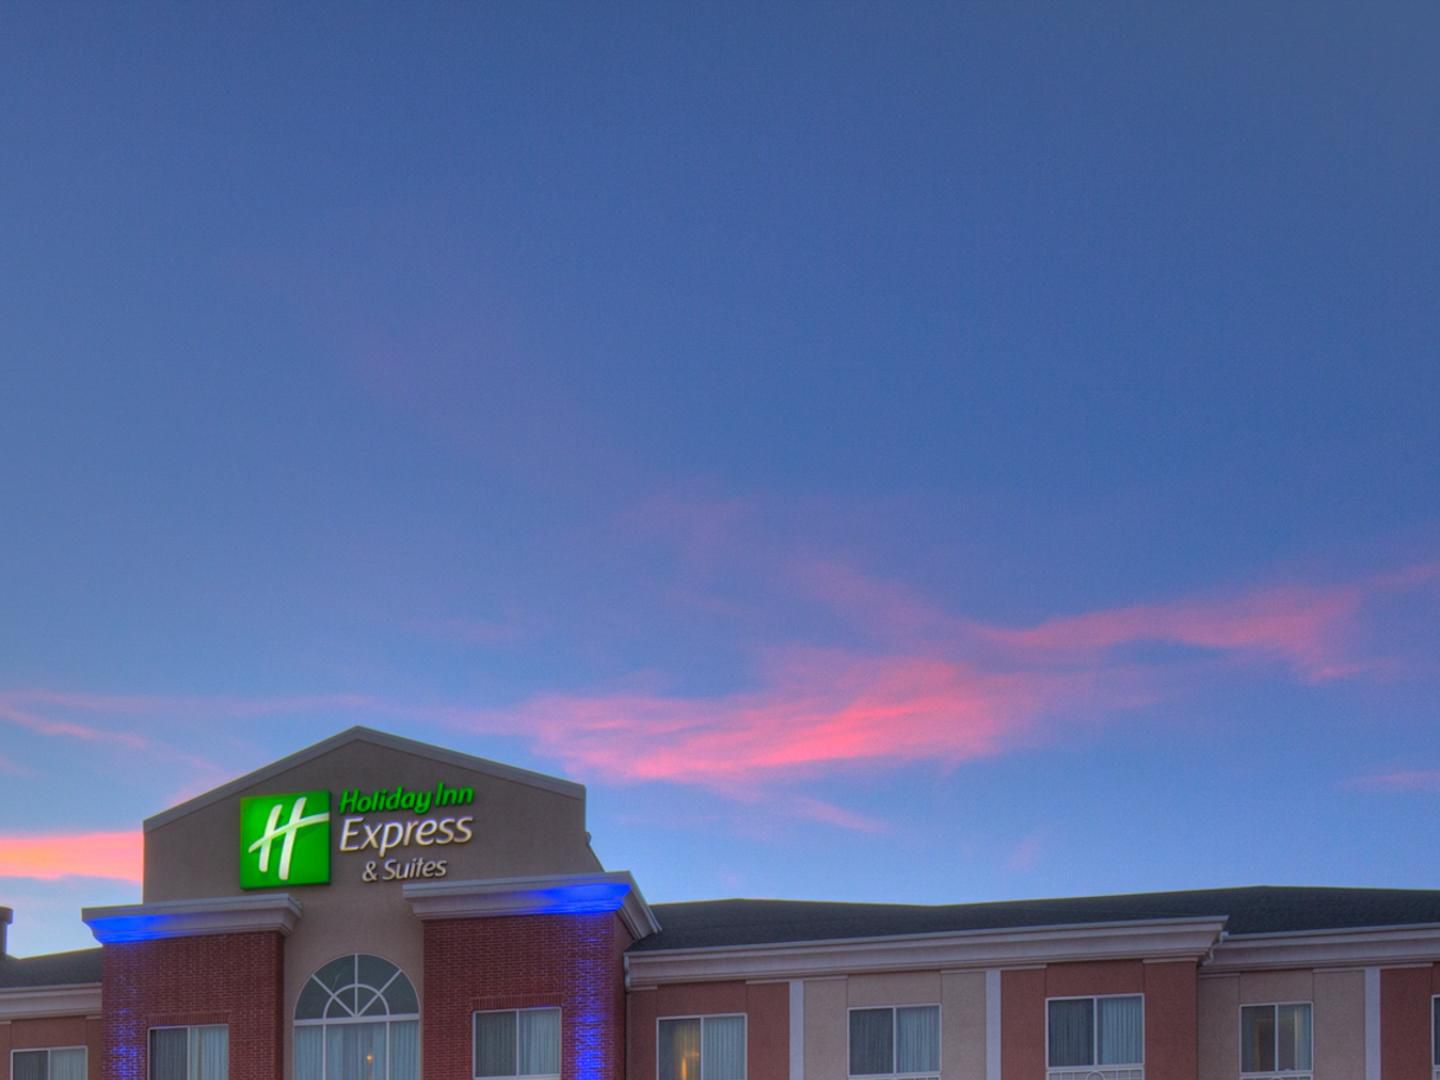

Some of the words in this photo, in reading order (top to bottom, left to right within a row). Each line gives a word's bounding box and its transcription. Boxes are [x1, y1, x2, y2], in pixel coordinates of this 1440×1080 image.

[339, 786, 432, 815] Holiday
[434, 781, 474, 807] Inn
[340, 816, 473, 857] Express
[362, 860, 378, 882] &
[382, 858, 447, 880] Suites
